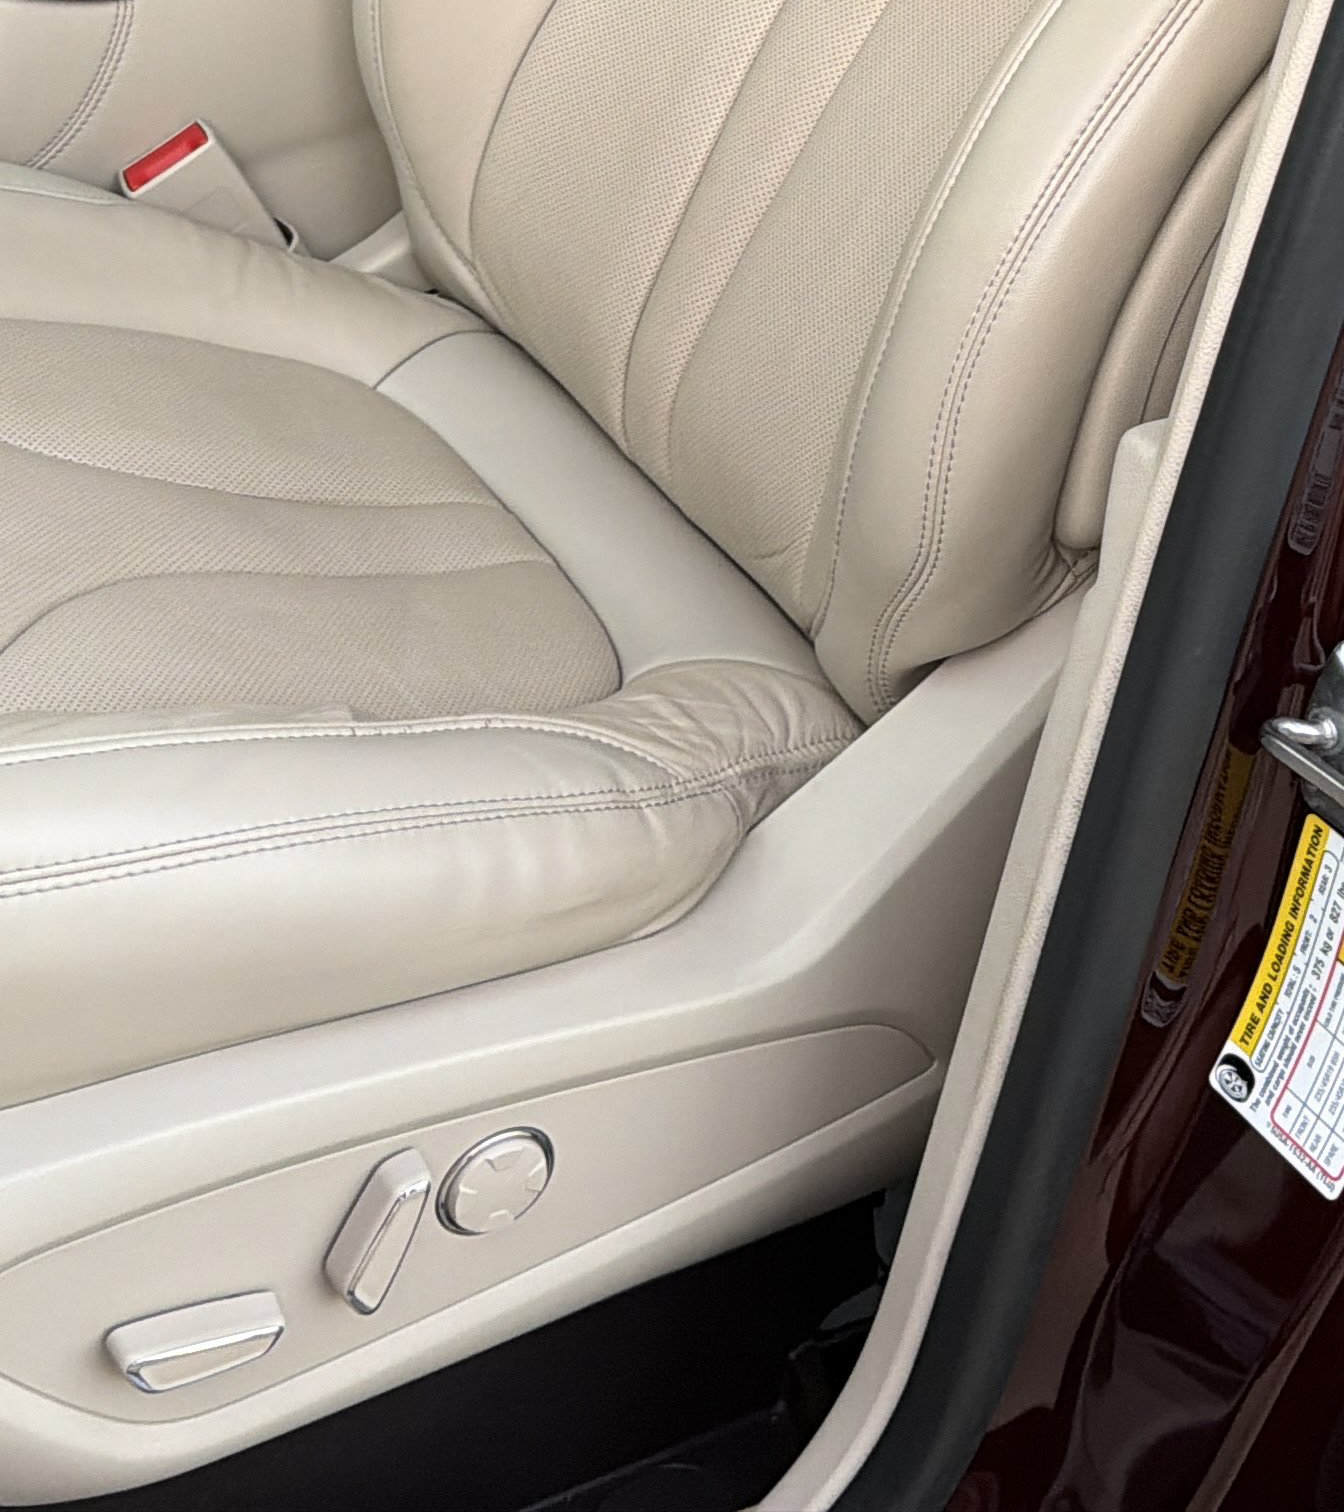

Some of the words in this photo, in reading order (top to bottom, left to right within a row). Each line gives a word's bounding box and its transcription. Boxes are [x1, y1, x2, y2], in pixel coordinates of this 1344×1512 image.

[1239, 1012, 1260, 1045] TIRE
[1255, 982, 1272, 1013] AND
[1267, 920, 1294, 981] LOADING
[1289, 824, 1322, 919] INFORMATION
[1311, 956, 1324, 980] 375
[1319, 940, 1332, 956] kg
[1328, 900, 1341, 923] 827
[1248, 1097, 1261, 1112] The
[1258, 1060, 1279, 1097] combined
[1276, 1034, 1292, 1060] weight
[1292, 987, 1310, 1026] occupants
[1267, 1008, 1283, 1040] CAPACITY
[1272, 1068, 1285, 1090] cargo
[1283, 1042, 1296, 1068] should
[1303, 993, 1316, 1021] exceed
[1294, 1115, 1308, 1139] FRONT
[1309, 1133, 1321, 1152] REAR
